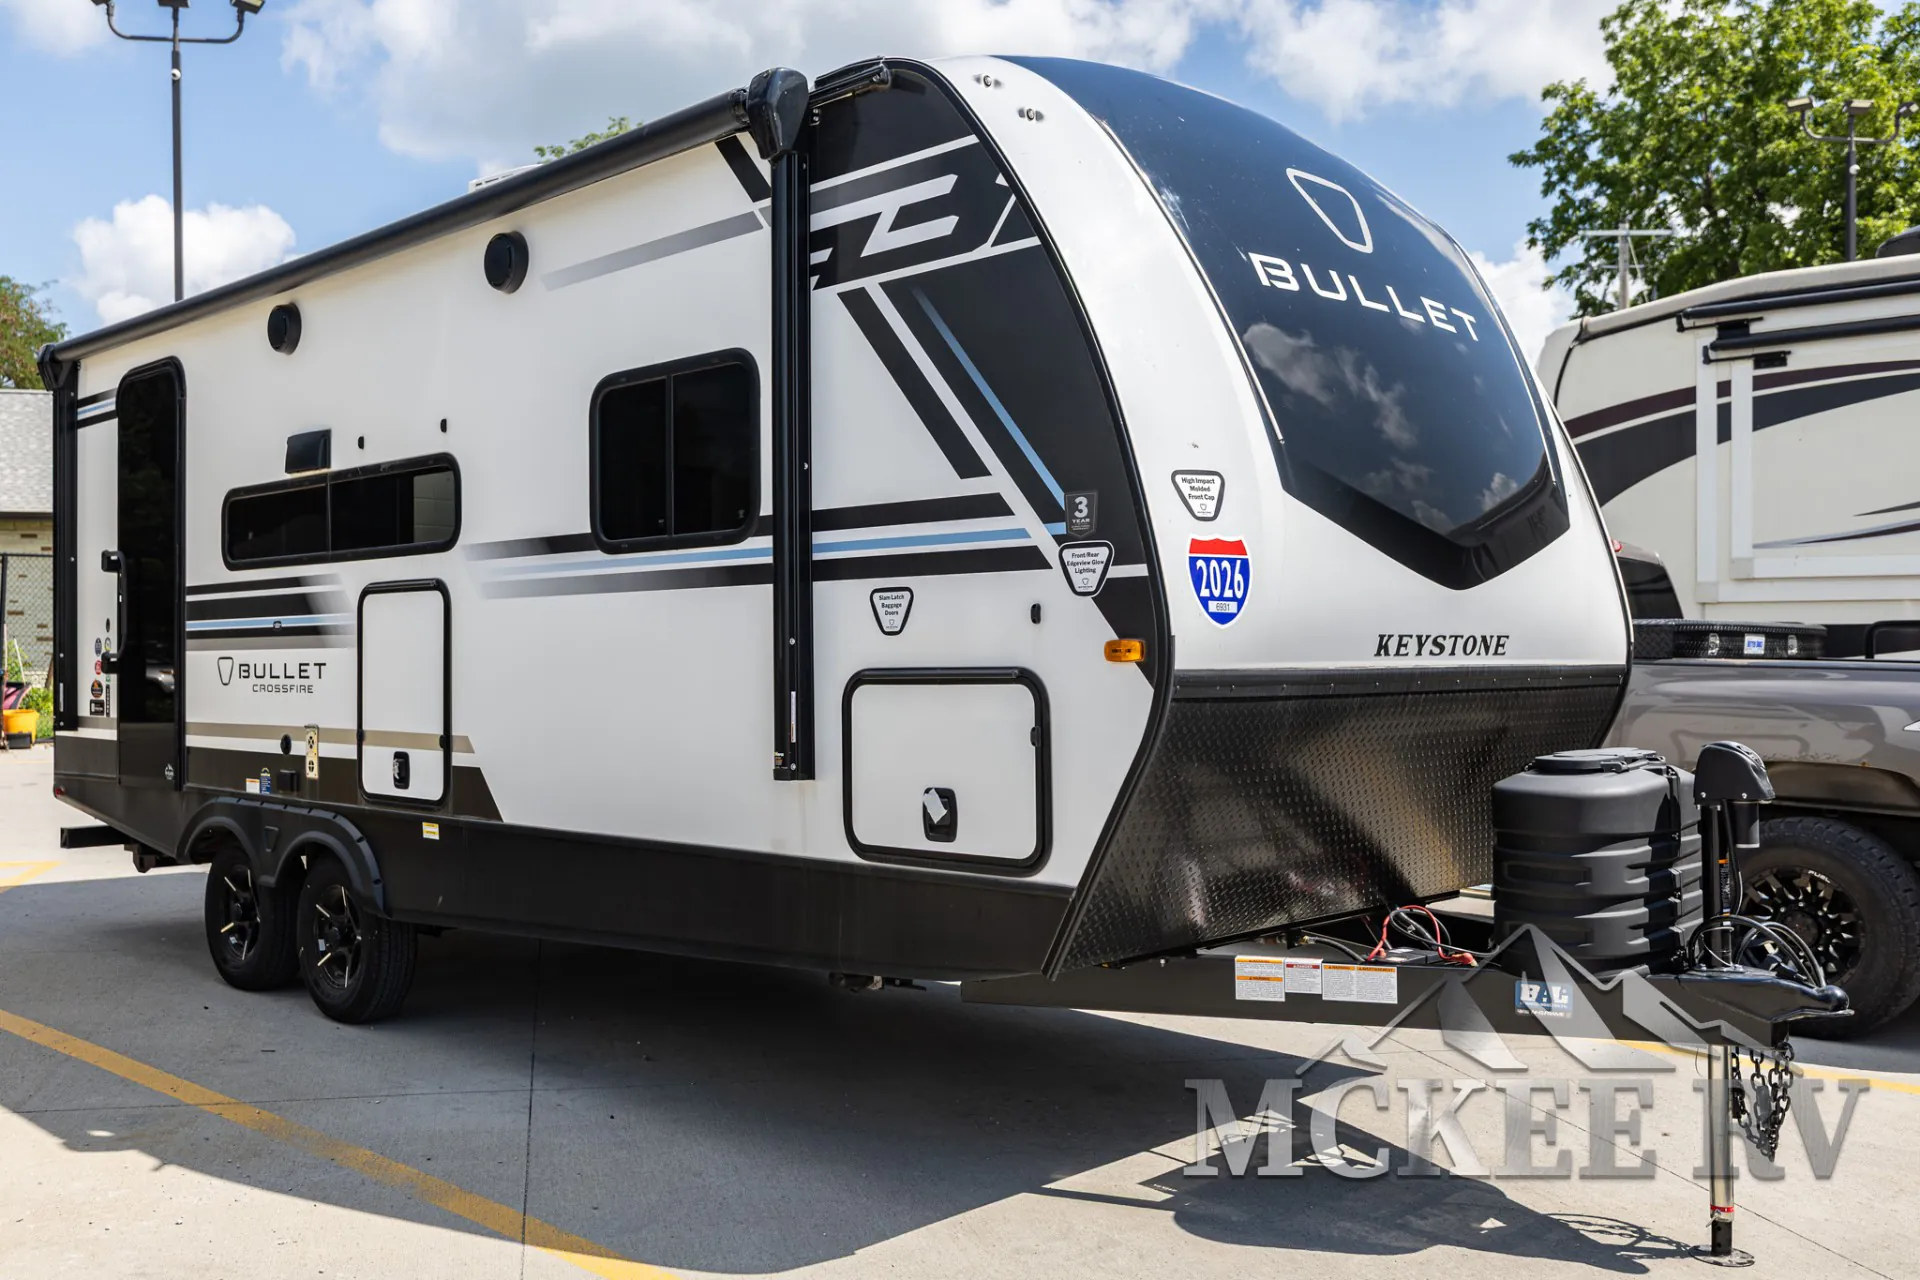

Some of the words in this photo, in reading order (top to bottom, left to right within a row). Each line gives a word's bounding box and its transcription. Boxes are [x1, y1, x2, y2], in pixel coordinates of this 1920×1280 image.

[1248, 252, 1478, 342] BULLET
[1204, 493, 1215, 501] Cap
[1074, 496, 1089, 518] 3
[1066, 560, 1091, 568] Edgeview
[1196, 559, 1245, 599] 2026
[1215, 602, 1230, 612] 6931
[1374, 633, 1510, 657] KEYSTONE
[238, 662, 327, 679] BULLET
[252, 684, 314, 694] CROSSFIRE
